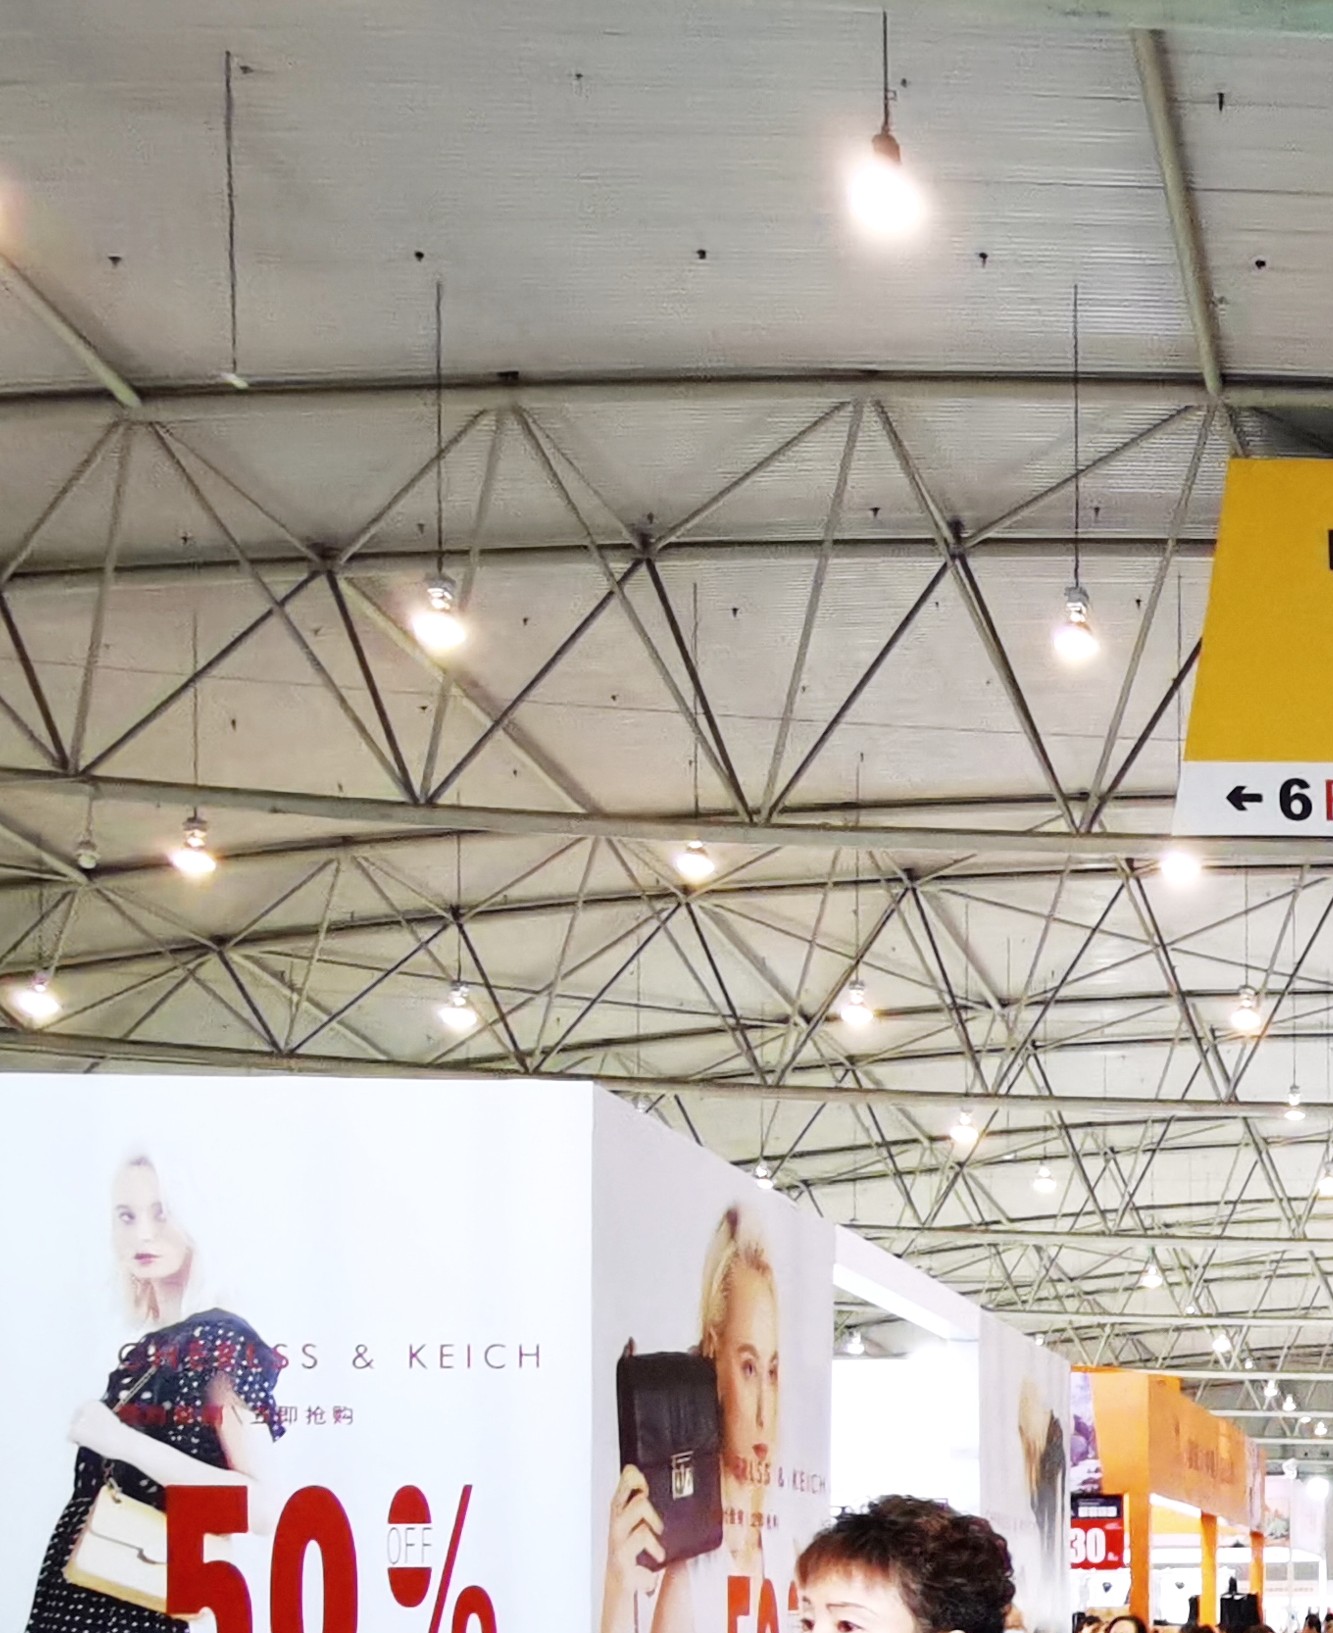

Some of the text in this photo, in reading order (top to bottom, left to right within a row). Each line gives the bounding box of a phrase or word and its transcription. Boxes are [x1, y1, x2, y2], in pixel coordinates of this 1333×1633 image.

[1279, 778, 1313, 821] 6
[352, 1344, 375, 1370] &
[408, 1343, 542, 1370] KEICH
[387, 1526, 433, 1566] OFF
